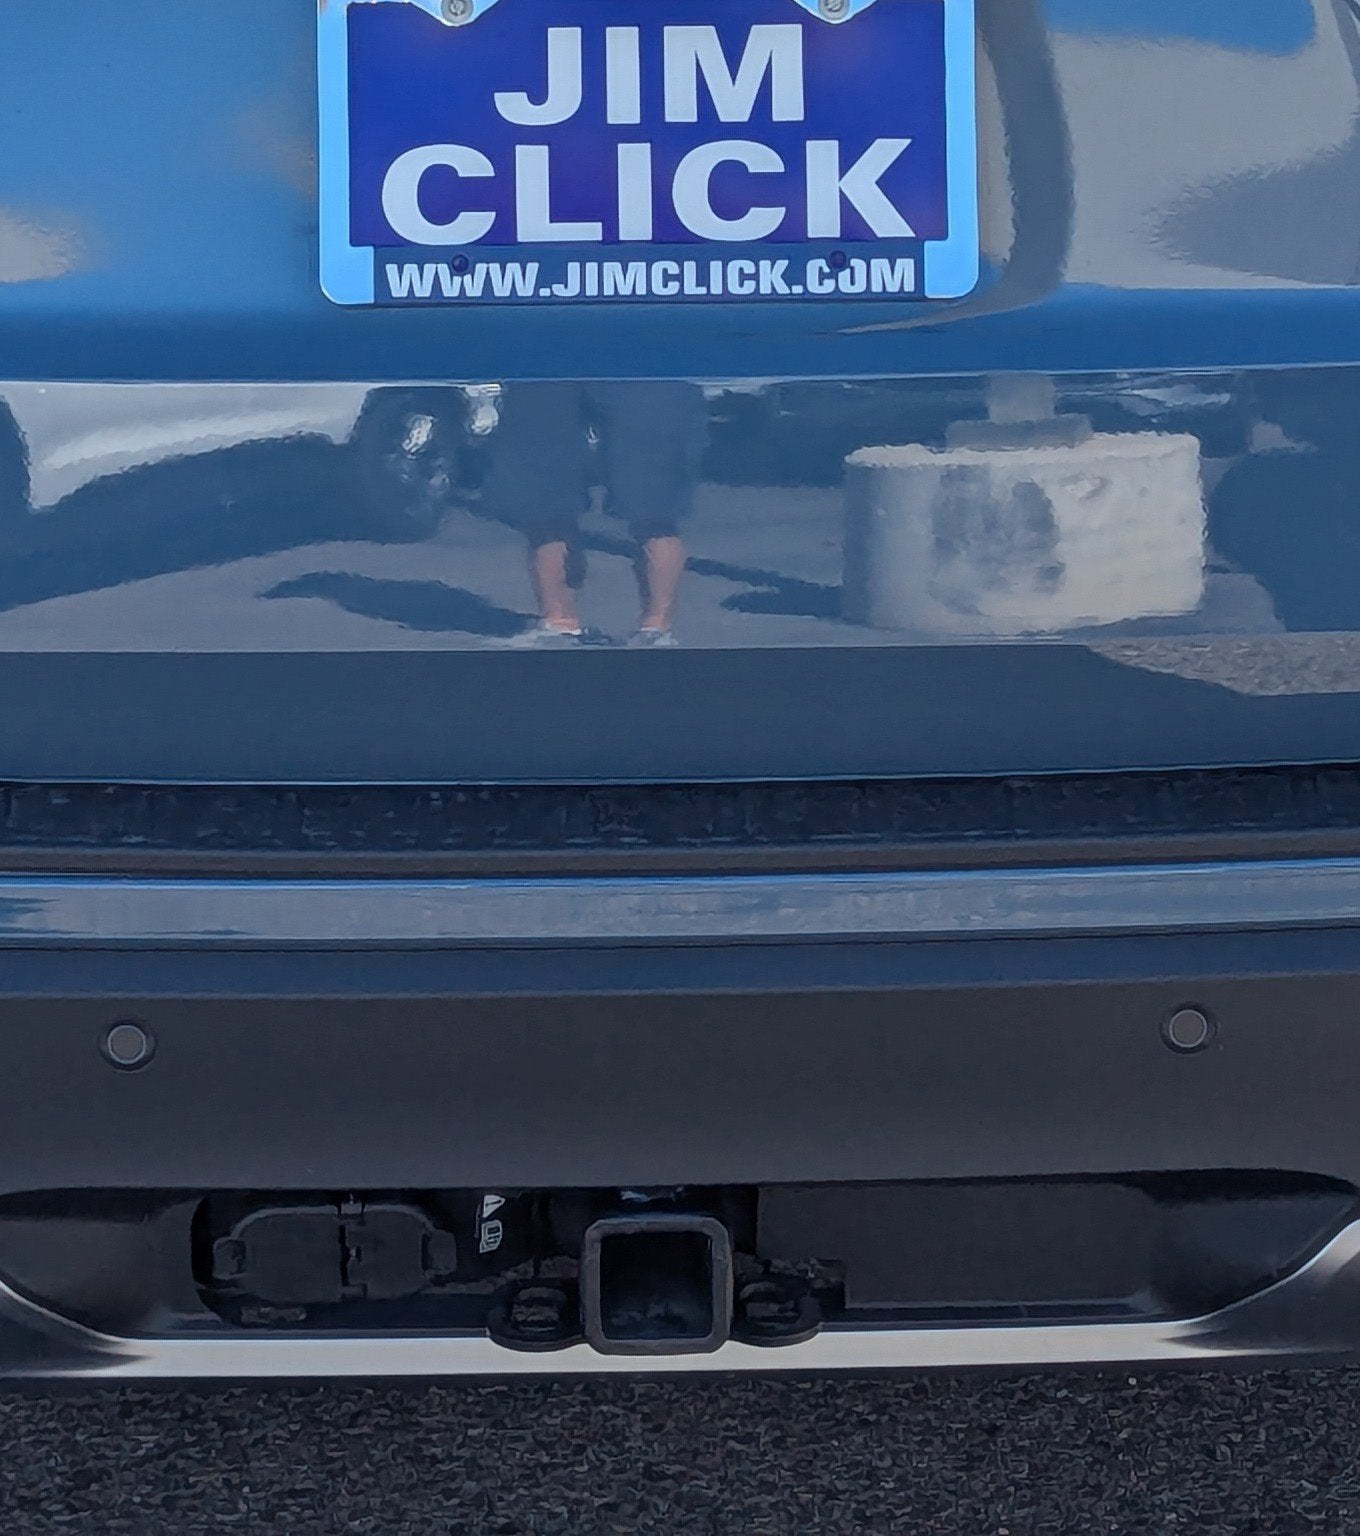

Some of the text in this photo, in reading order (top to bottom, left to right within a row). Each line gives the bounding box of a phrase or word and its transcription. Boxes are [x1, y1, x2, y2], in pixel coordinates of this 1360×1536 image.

[493, 23, 804, 126] JIM
[381, 137, 917, 246] CLICK
[385, 257, 916, 298] WWW.JIMCLICK.COM
